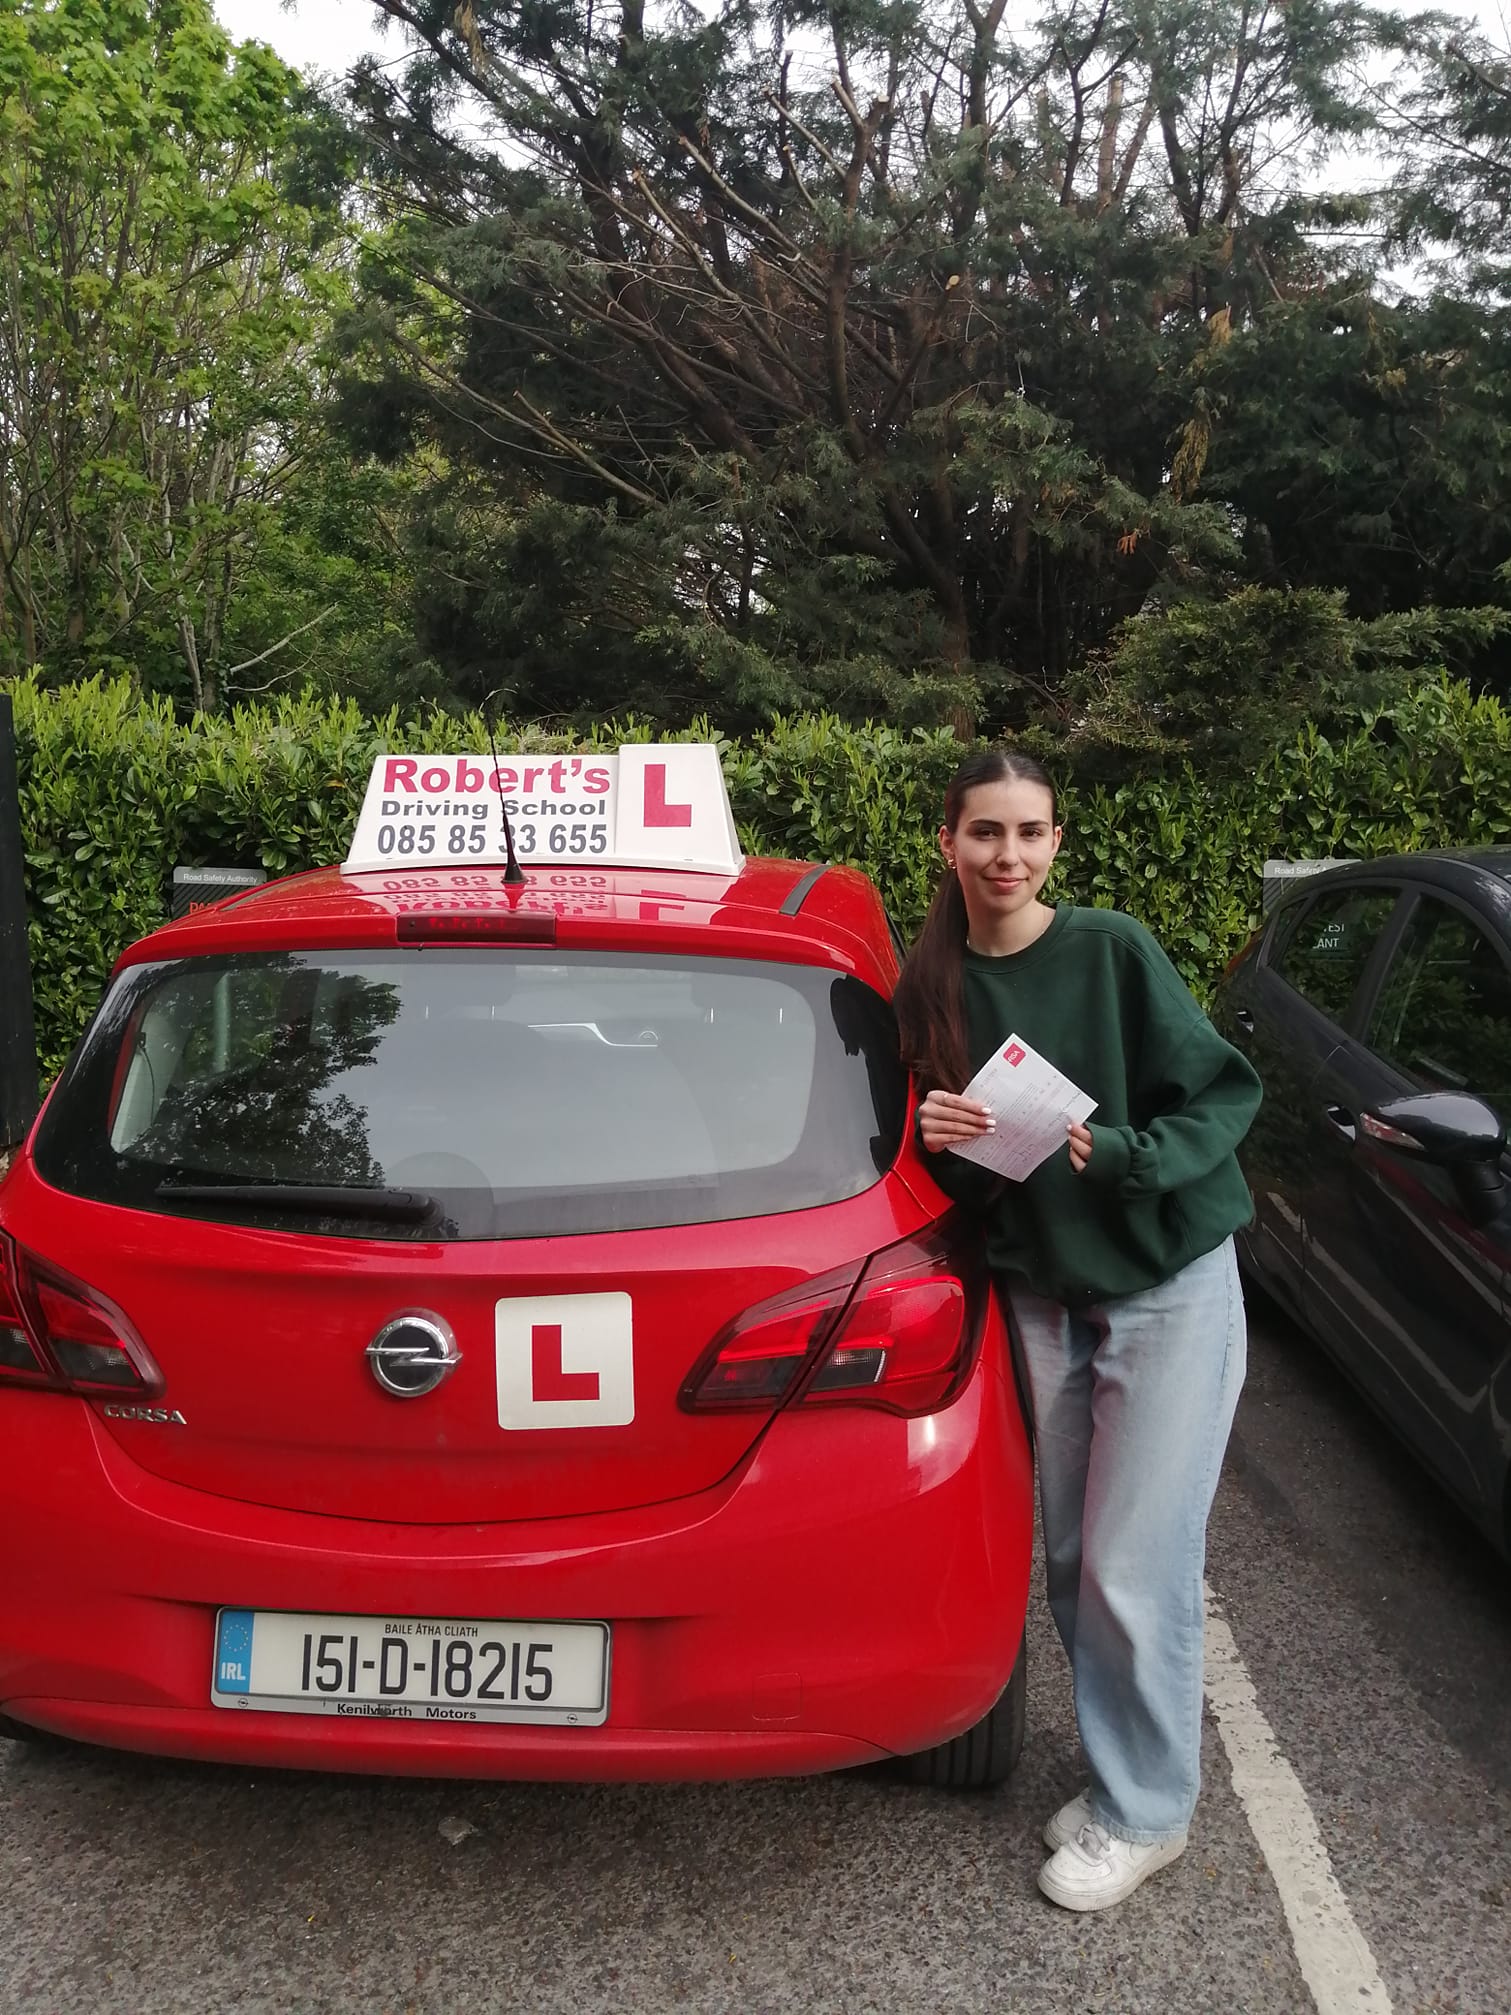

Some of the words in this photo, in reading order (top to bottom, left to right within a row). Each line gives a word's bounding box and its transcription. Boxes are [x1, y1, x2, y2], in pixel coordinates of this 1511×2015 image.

[383, 758, 611, 794] Robert's
[643, 763, 692, 827] L
[381, 801, 489, 820] Driving
[502, 799, 606, 817] School
[377, 824, 436, 854] 085
[447, 824, 487, 854] 85
[549, 824, 608, 854] 655
[183, 873, 202, 882] Road
[203, 874, 225, 883] Safety
[227, 875, 257, 884] Authority
[1274, 867, 1295, 875] Road
[532, 1324, 600, 1402] L
[104, 1405, 187, 1424] CORSA
[385, 1624, 412, 1634] BAILE
[444, 1625, 478, 1637] CLIATH
[221, 1661, 246, 1681] IRL
[301, 1633, 554, 1702] 151-D-18215
[425, 1707, 477, 1719] Motors
